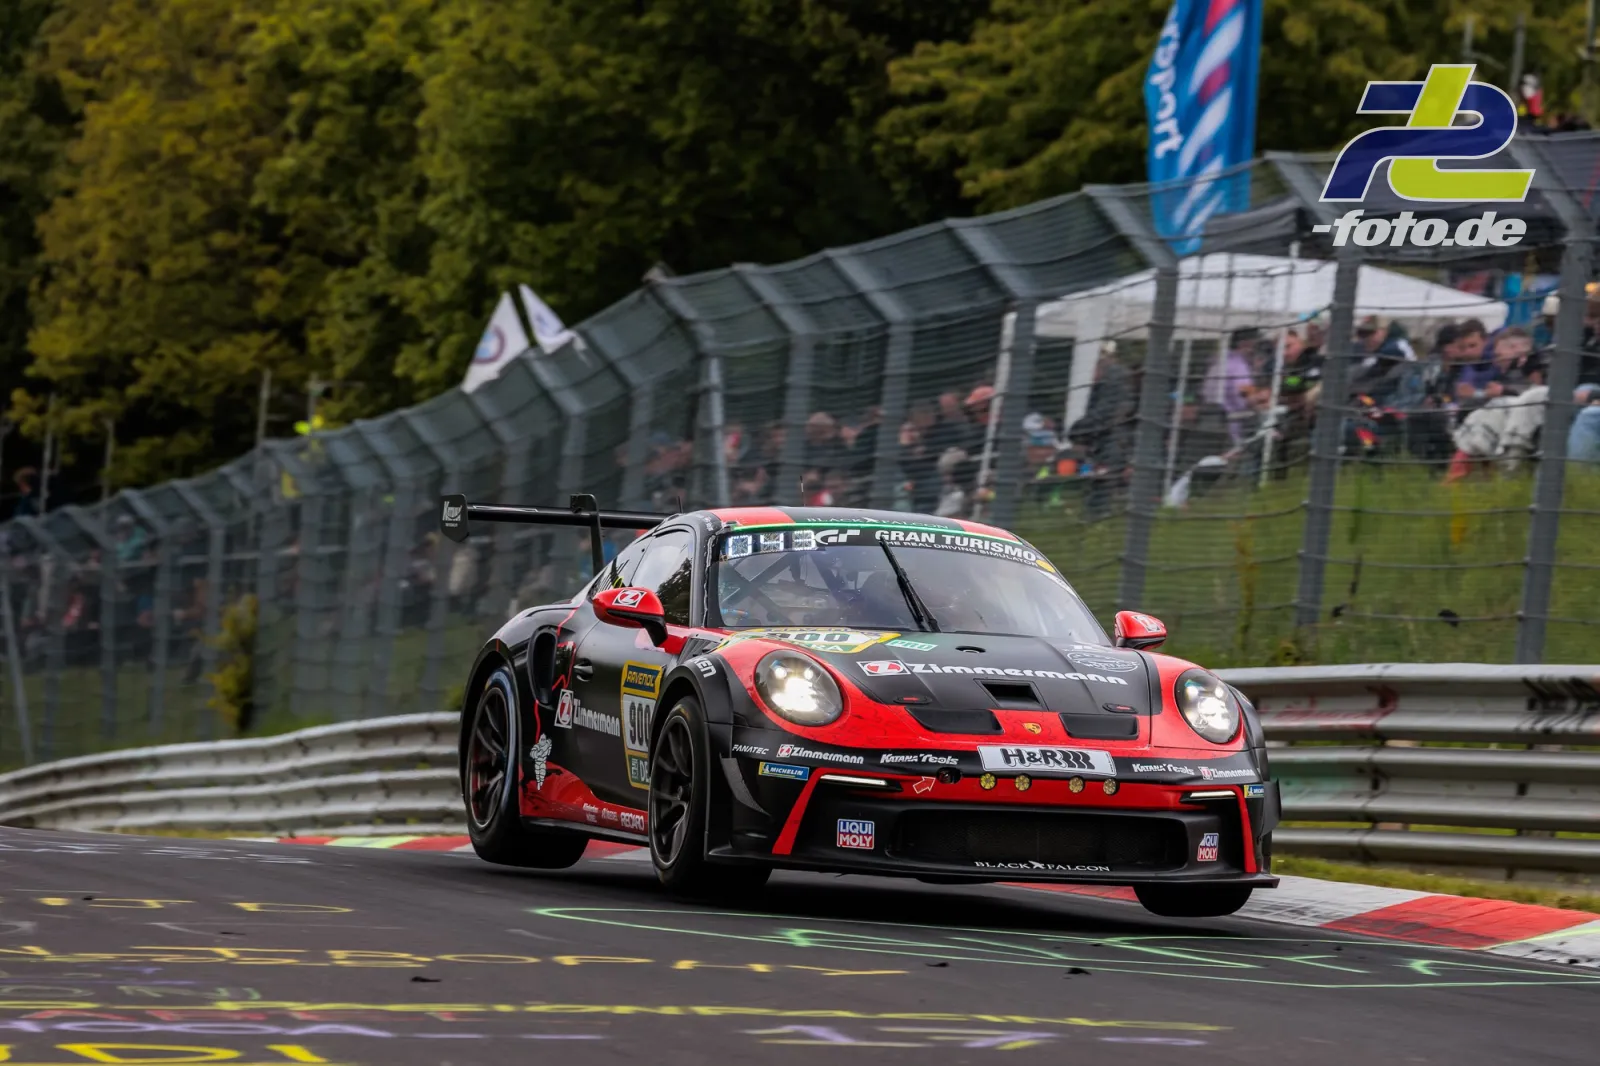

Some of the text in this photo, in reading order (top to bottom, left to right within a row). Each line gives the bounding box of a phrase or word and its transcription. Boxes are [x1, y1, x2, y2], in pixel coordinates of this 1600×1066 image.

[875, 530, 1037, 562] GRAN TURISMO
[934, 544, 978, 553] DRIVING
[979, 549, 1039, 567] SIMULATOR
[907, 663, 1128, 685] Zimmermann
[573, 698, 620, 737] Zimmermann
[731, 744, 769, 756] FANATEC
[791, 746, 864, 764] Zimmermann
[769, 766, 804, 776] MICHELIN
[839, 821, 872, 834] LIQUI
[839, 834, 873, 848] MOLY
[1199, 847, 1217, 859] MOLY
[974, 861, 1110, 872] BLACK FALCON
[127, 946, 910, 976] TROPHY
